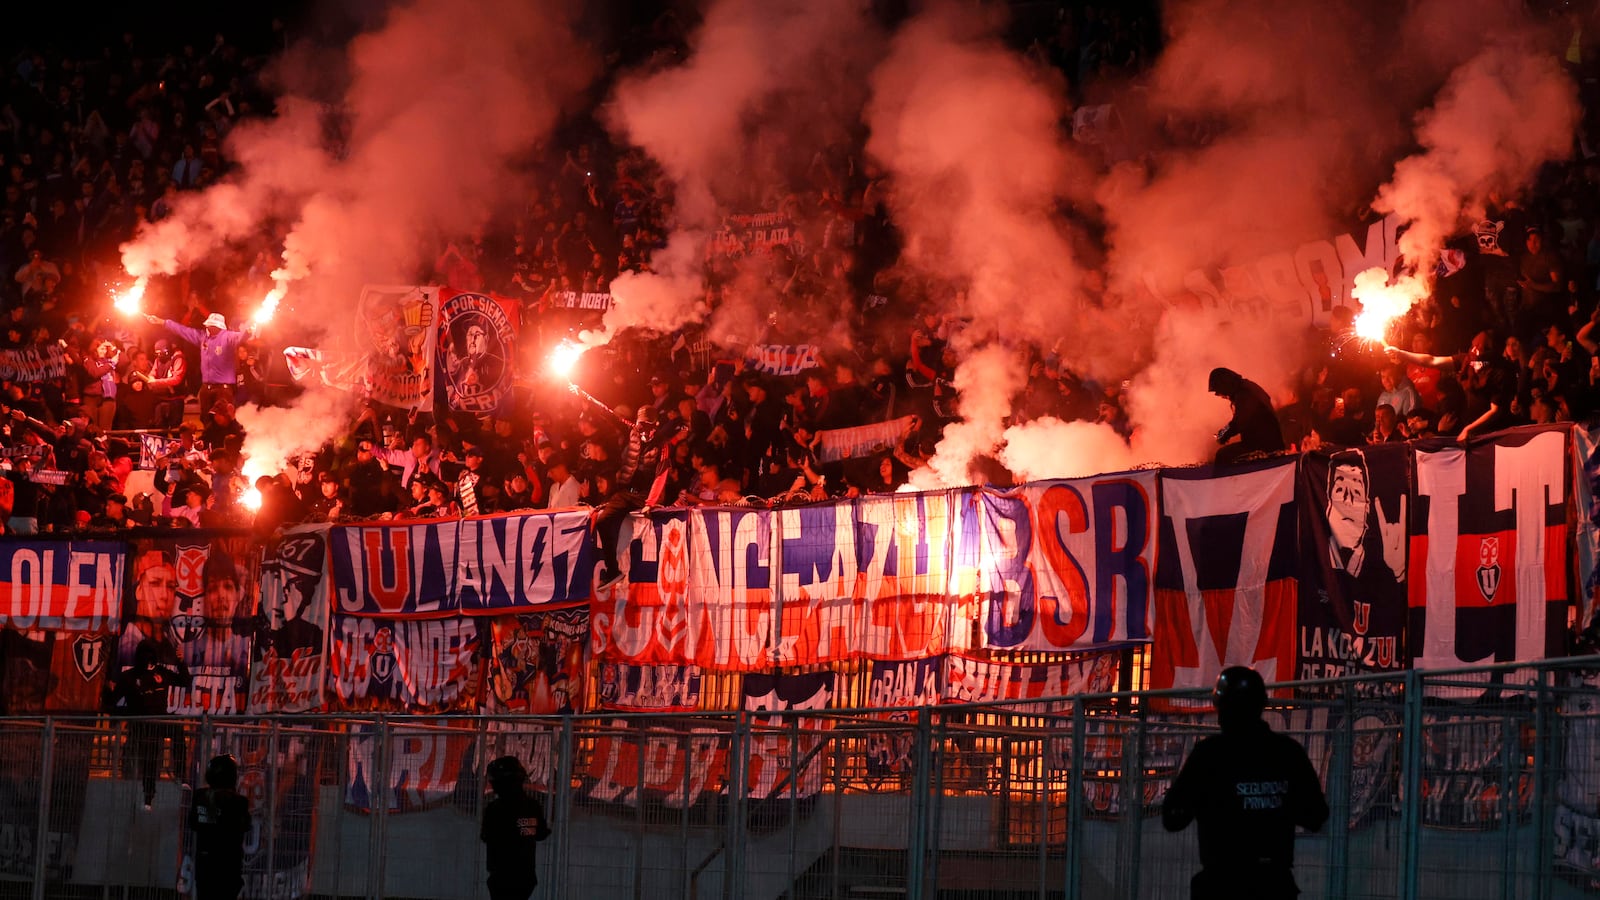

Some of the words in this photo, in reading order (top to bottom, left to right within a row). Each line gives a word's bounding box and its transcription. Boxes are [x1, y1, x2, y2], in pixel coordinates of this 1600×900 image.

[451, 295, 475, 315] POR
[478, 296, 516, 344] SIEMPRE
[984, 478, 1151, 648] BSR
[0, 548, 126, 632] OLEN
[1353, 600, 1371, 635] U
[80, 642, 102, 673] U
[1301, 626, 1323, 658] LA
[375, 655, 391, 678] U
[166, 675, 238, 715] ULETA
